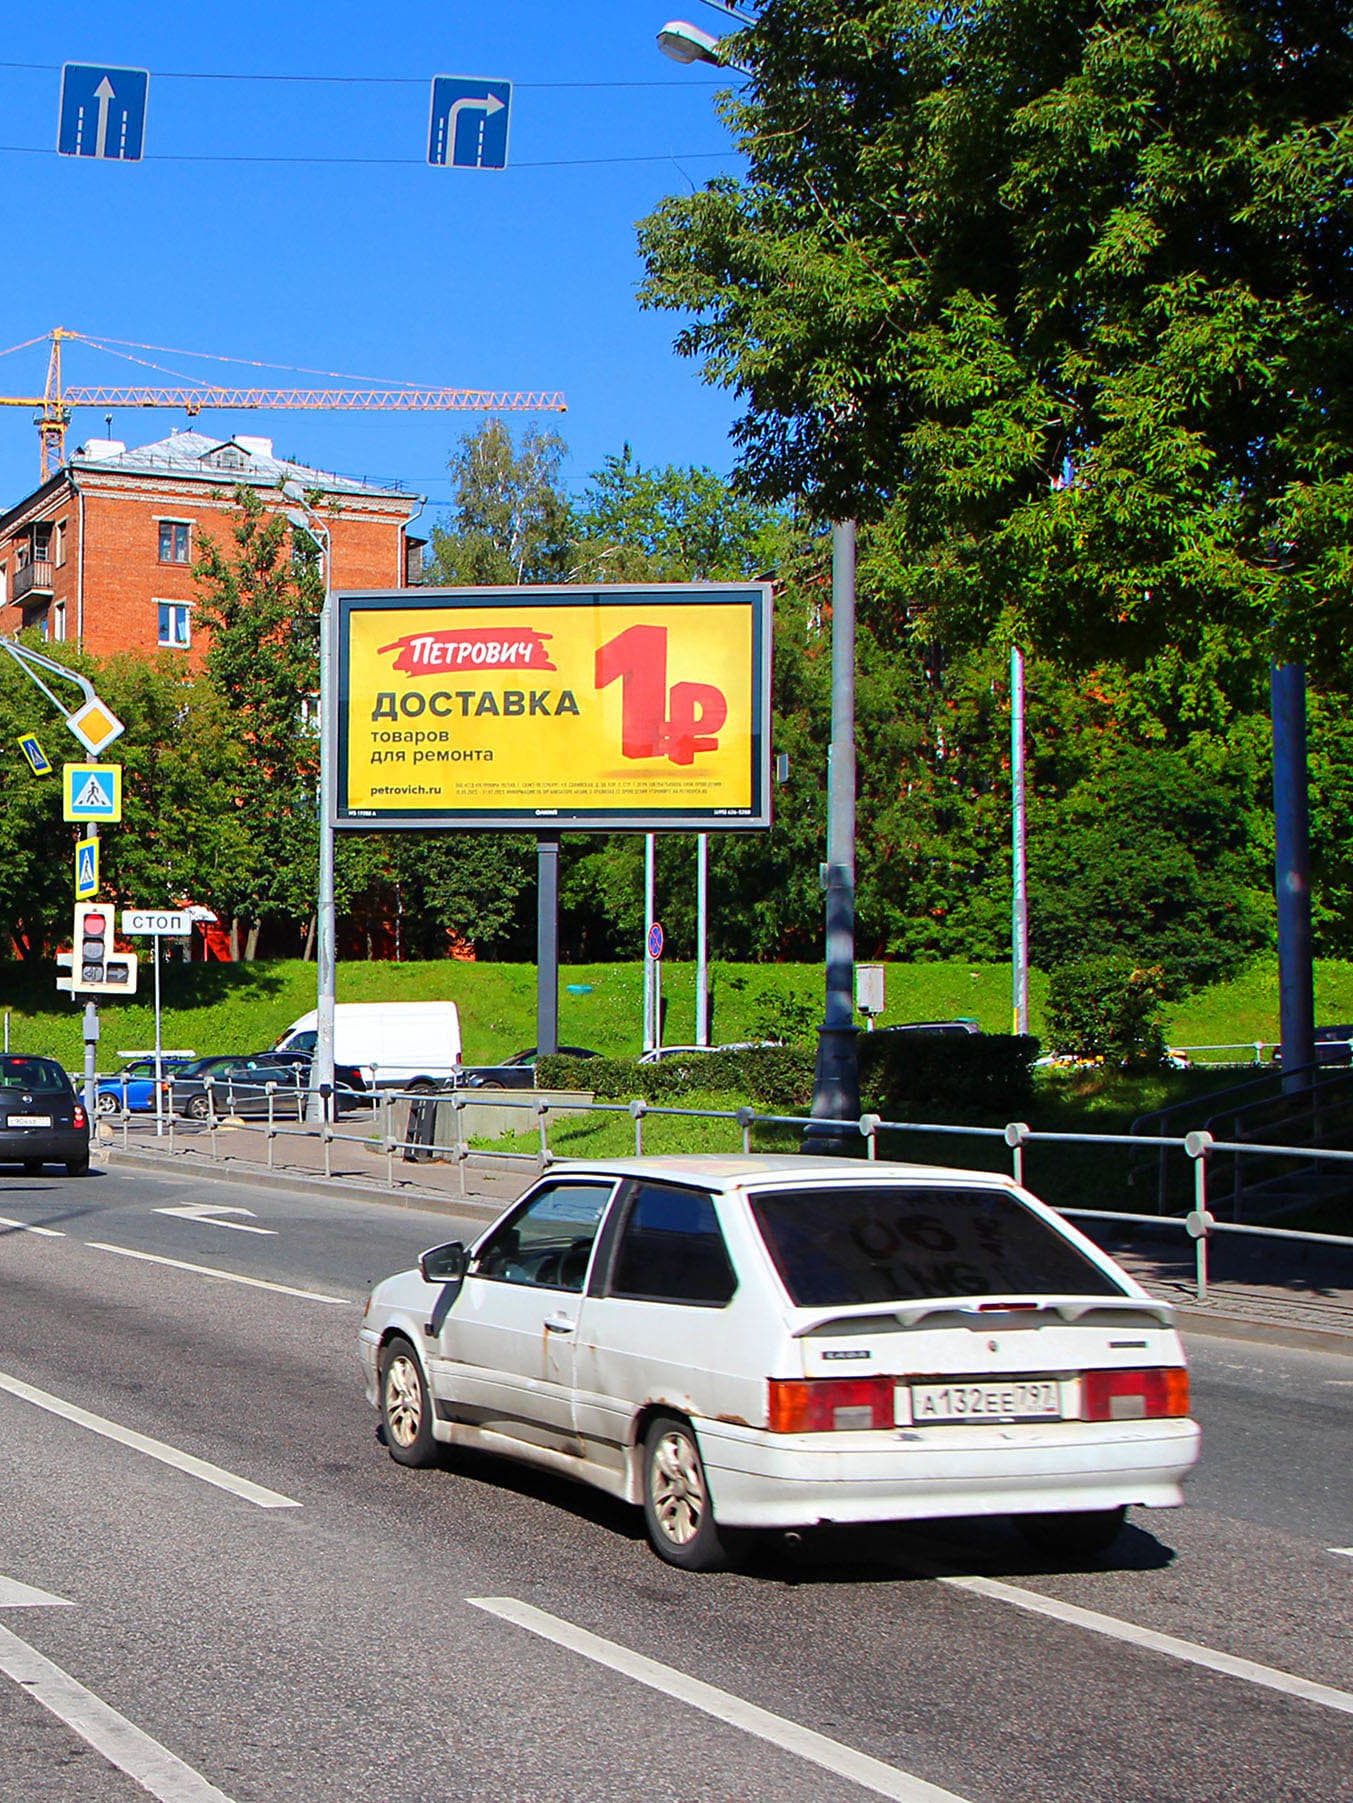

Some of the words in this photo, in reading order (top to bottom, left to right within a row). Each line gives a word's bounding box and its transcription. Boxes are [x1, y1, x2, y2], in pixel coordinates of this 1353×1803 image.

[410, 637, 534, 665] ПЕТРОВИЧ
[371, 690, 580, 722] ДОСТАВКА
[370, 729, 449, 746] товаров
[370, 749, 406, 765] для
[413, 748, 494, 764] ремонта
[370, 784, 442, 797] petrovich.ru
[132, 916, 181, 929] СТОП
